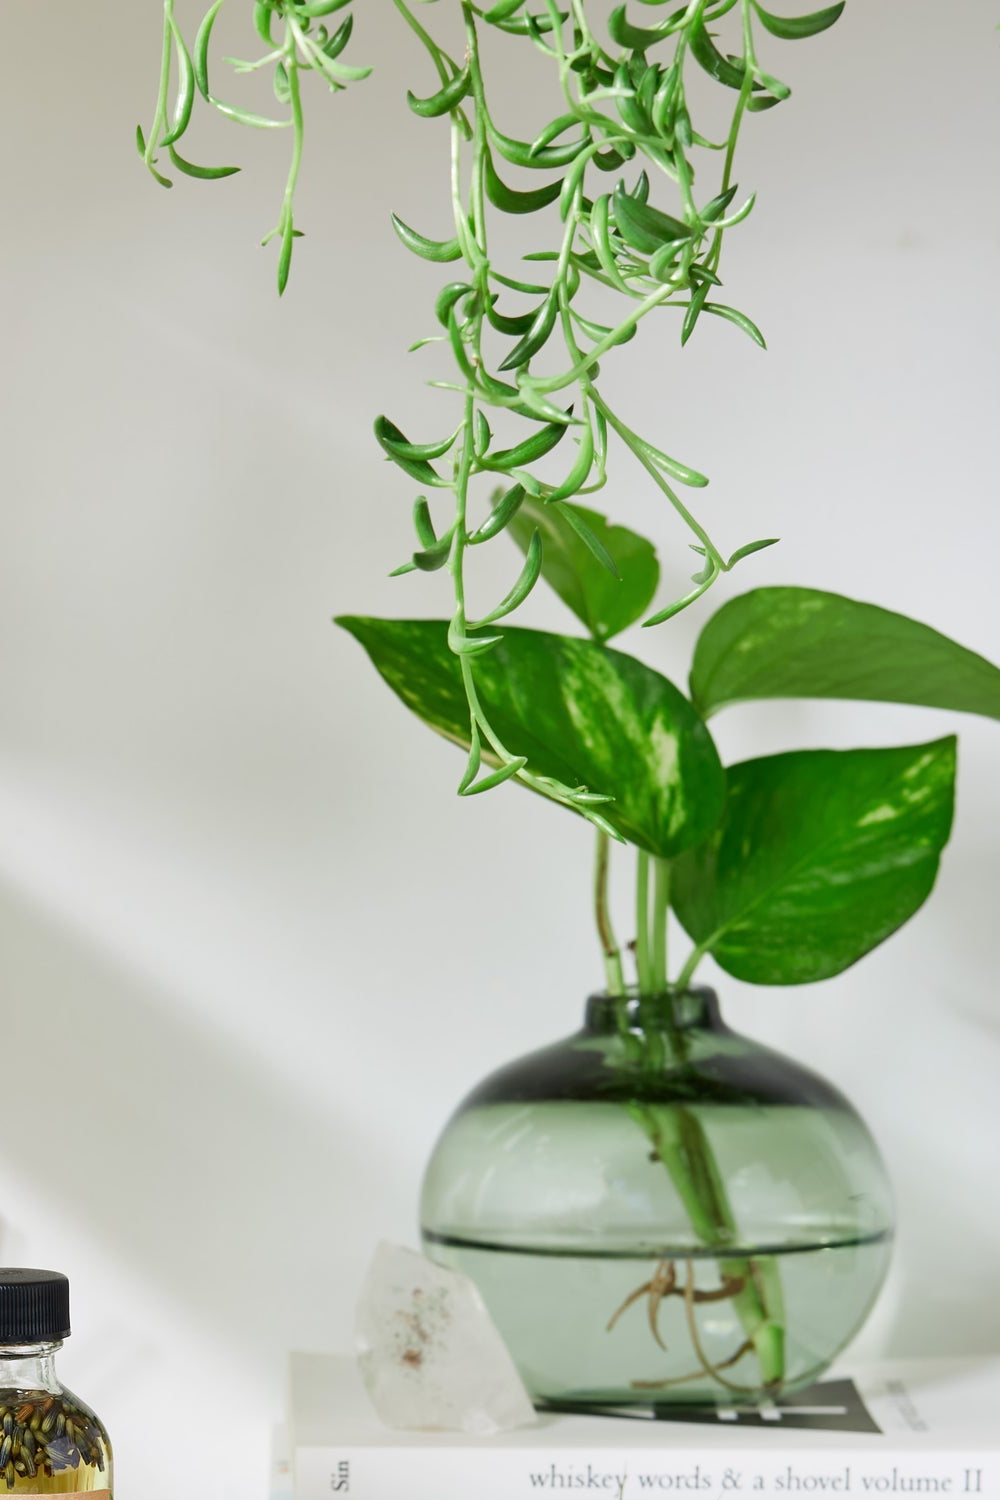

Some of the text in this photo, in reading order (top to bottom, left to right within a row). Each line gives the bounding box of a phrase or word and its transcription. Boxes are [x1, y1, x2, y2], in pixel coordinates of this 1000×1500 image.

[331, 1460, 350, 1492] Sin
[529, 1464, 983, 1498] whiskey words & a shovel volume II
